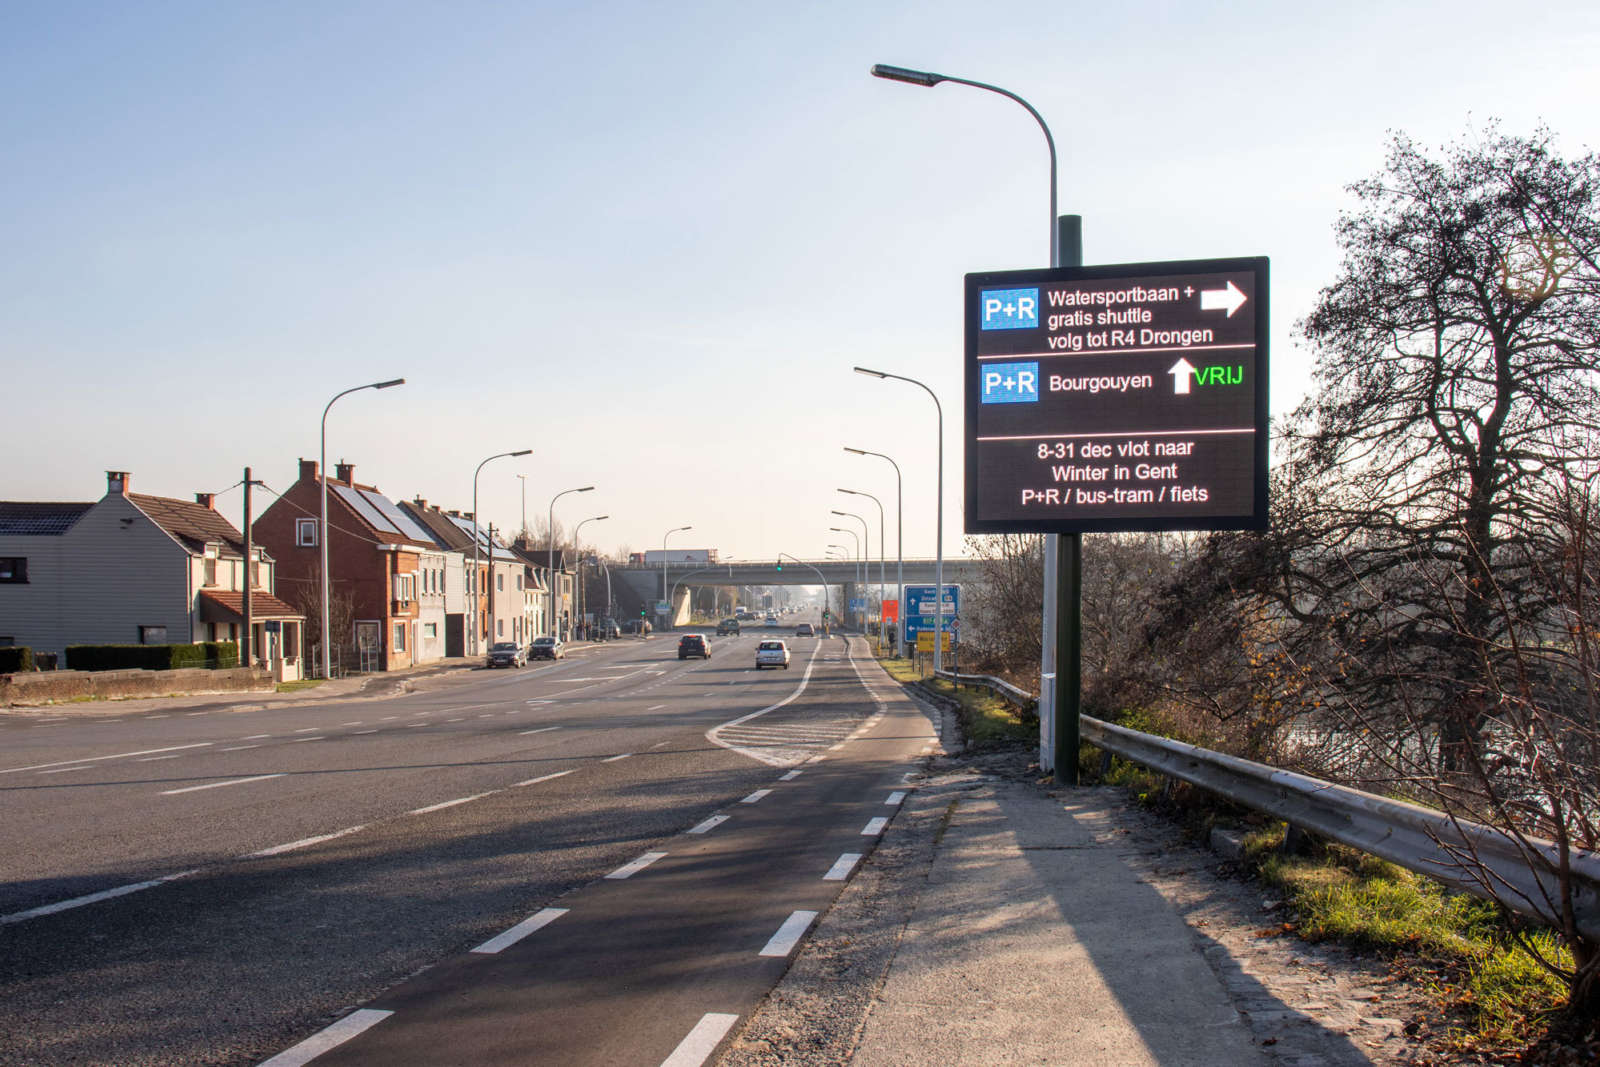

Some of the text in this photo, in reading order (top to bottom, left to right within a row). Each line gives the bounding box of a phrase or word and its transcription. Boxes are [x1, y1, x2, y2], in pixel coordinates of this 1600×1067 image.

[1048, 287, 1178, 307] Watersportbaan
[986, 298, 1034, 321] P+R
[1048, 308, 1151, 330] gratis shuttle
[1048, 329, 1212, 351] volg tot R4 Drongen
[986, 371, 1035, 394] P+R
[1050, 376, 1151, 393] Bourgouyen
[1195, 365, 1243, 386] VRIJ
[1038, 441, 1194, 458] 8-31 dec vlot naar
[1052, 464, 1177, 481] Winter in Gent
[1023, 486, 1207, 504] P+R / bus-tram / fiets
